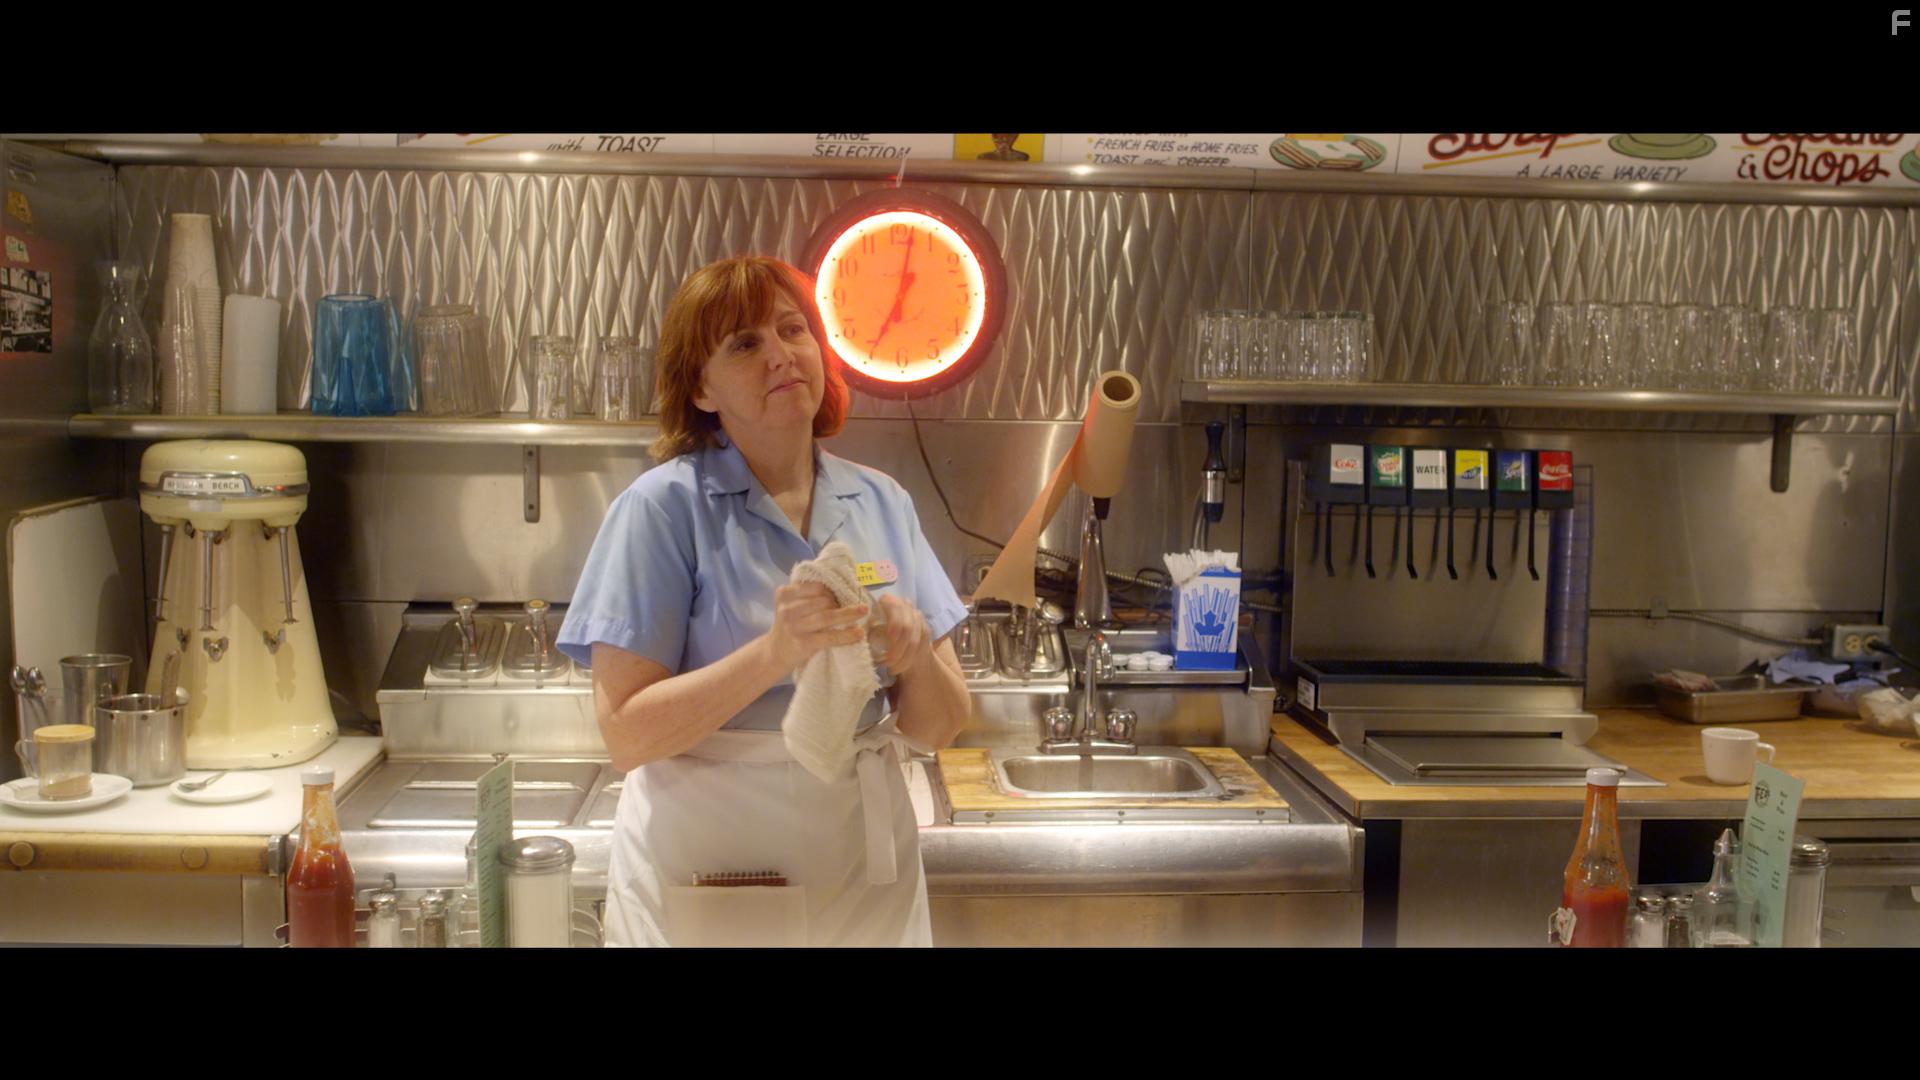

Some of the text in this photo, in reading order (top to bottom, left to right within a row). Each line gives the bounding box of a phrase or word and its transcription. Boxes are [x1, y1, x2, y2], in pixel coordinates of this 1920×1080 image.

[595, 136, 665, 152] TOAST
[1094, 138, 1141, 151] FRENCH
[1143, 140, 1176, 152] FRIES
[1190, 142, 1223, 153] HOME
[1093, 153, 1140, 165] TOAST
[1737, 140, 1890, 186] & Chops
[1517, 164, 1688, 182] A LARGE VARIETY
[212, 482, 240, 490] BEACH
